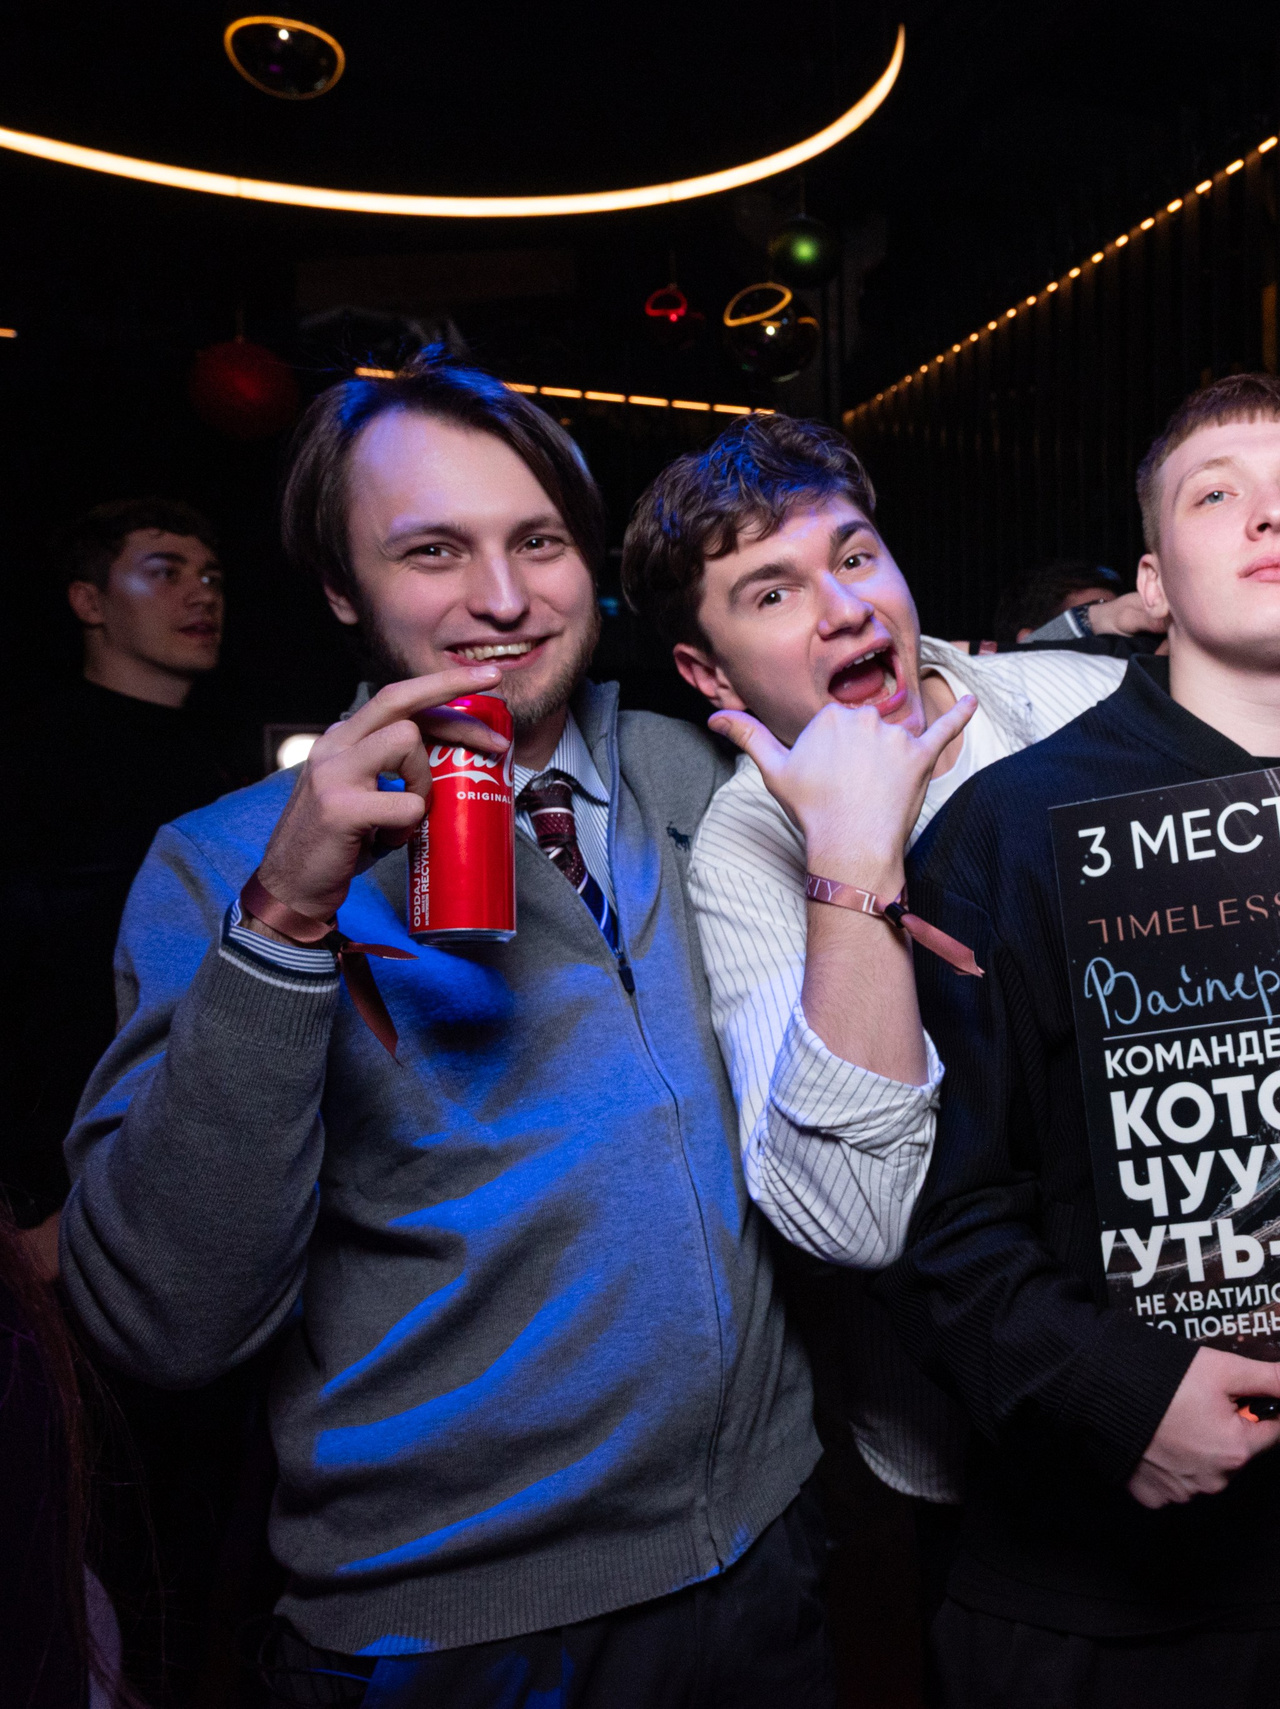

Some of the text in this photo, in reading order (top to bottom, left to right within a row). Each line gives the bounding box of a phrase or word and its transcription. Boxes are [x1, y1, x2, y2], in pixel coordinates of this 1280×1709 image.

[456, 791, 512, 804] ORIGINAL
[1078, 826, 1112, 878] 3
[413, 877, 421, 927] ODDAJ
[1135, 1294, 1167, 1316] НЕ
